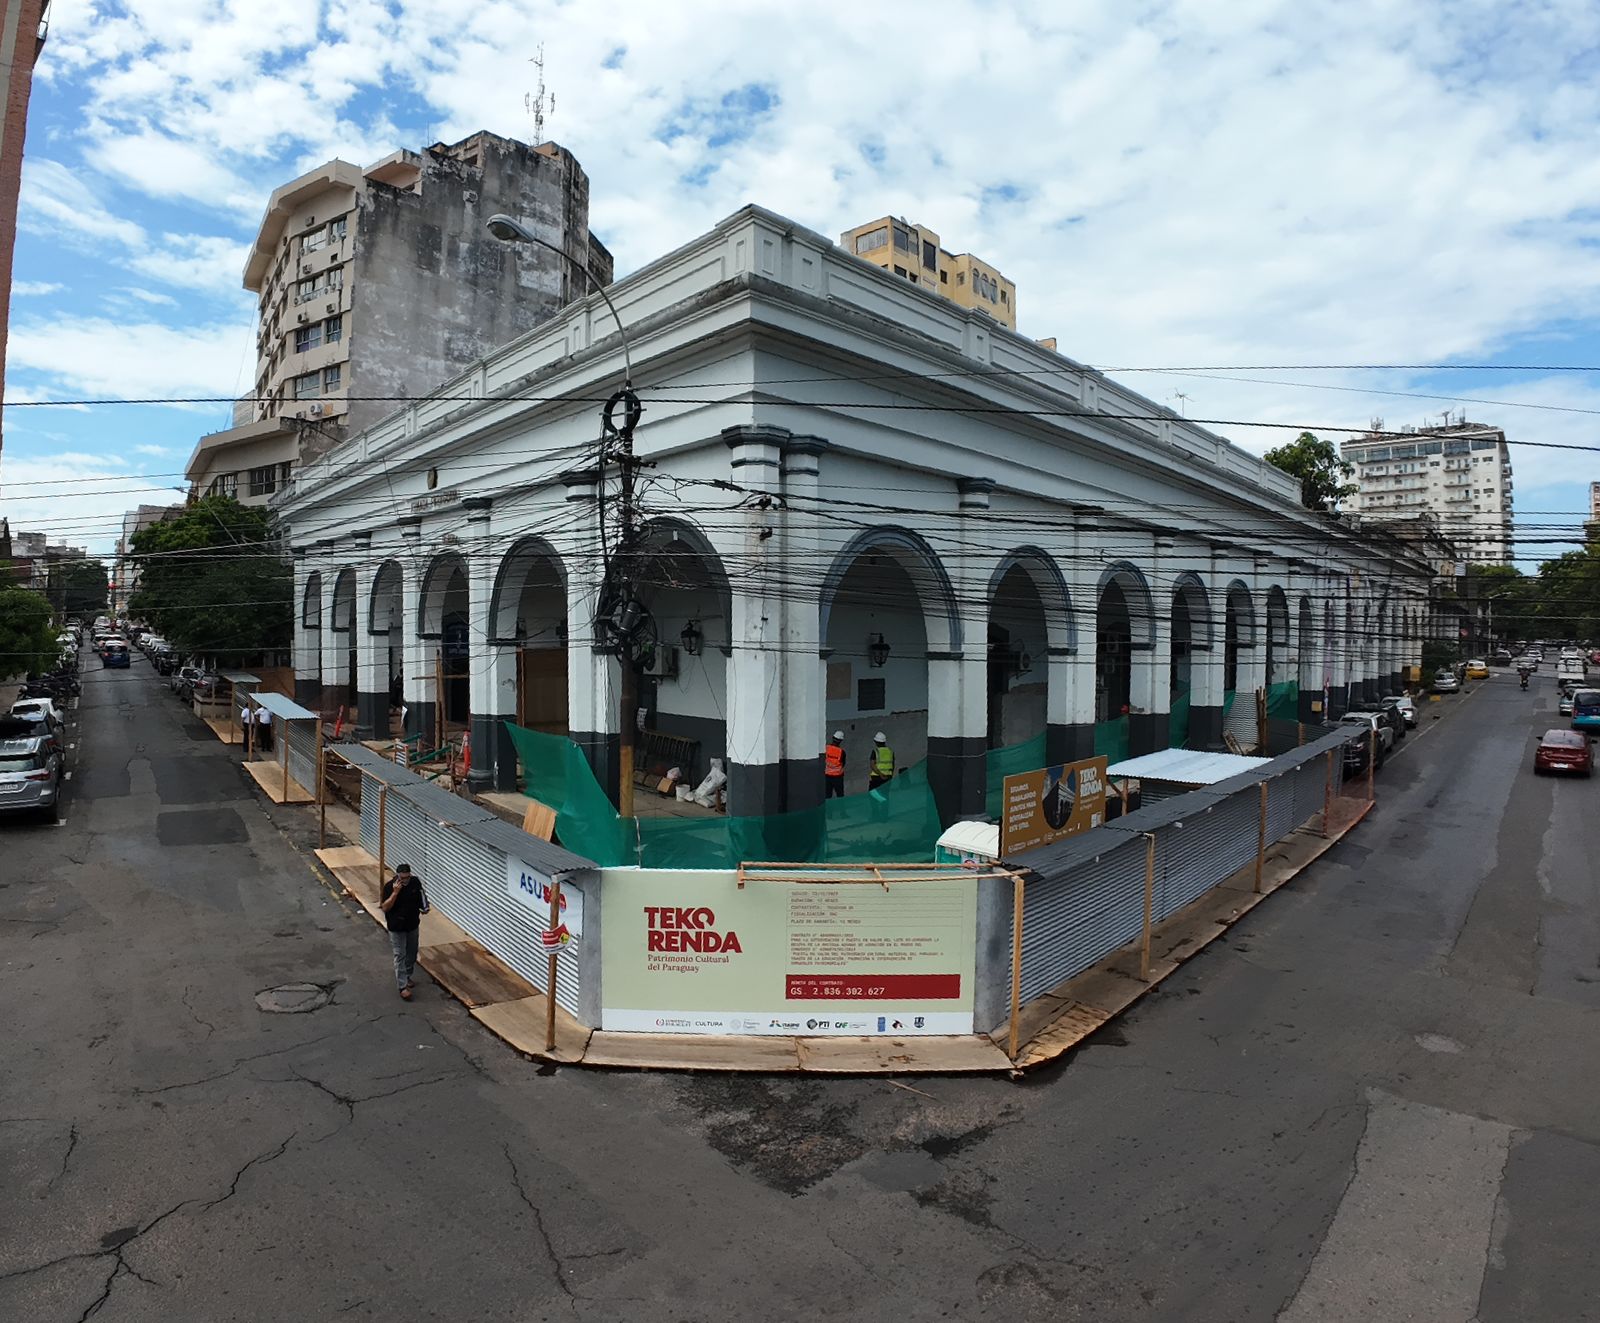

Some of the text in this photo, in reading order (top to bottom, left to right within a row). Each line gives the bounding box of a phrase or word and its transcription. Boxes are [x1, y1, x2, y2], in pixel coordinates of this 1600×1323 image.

[644, 907, 715, 930] TEKO
[647, 930, 743, 953] RENDA
[647, 954, 729, 963] Patrimonio Cultural
[647, 963, 700, 973] del Paraguay
[818, 1020, 830, 1029] PTI
